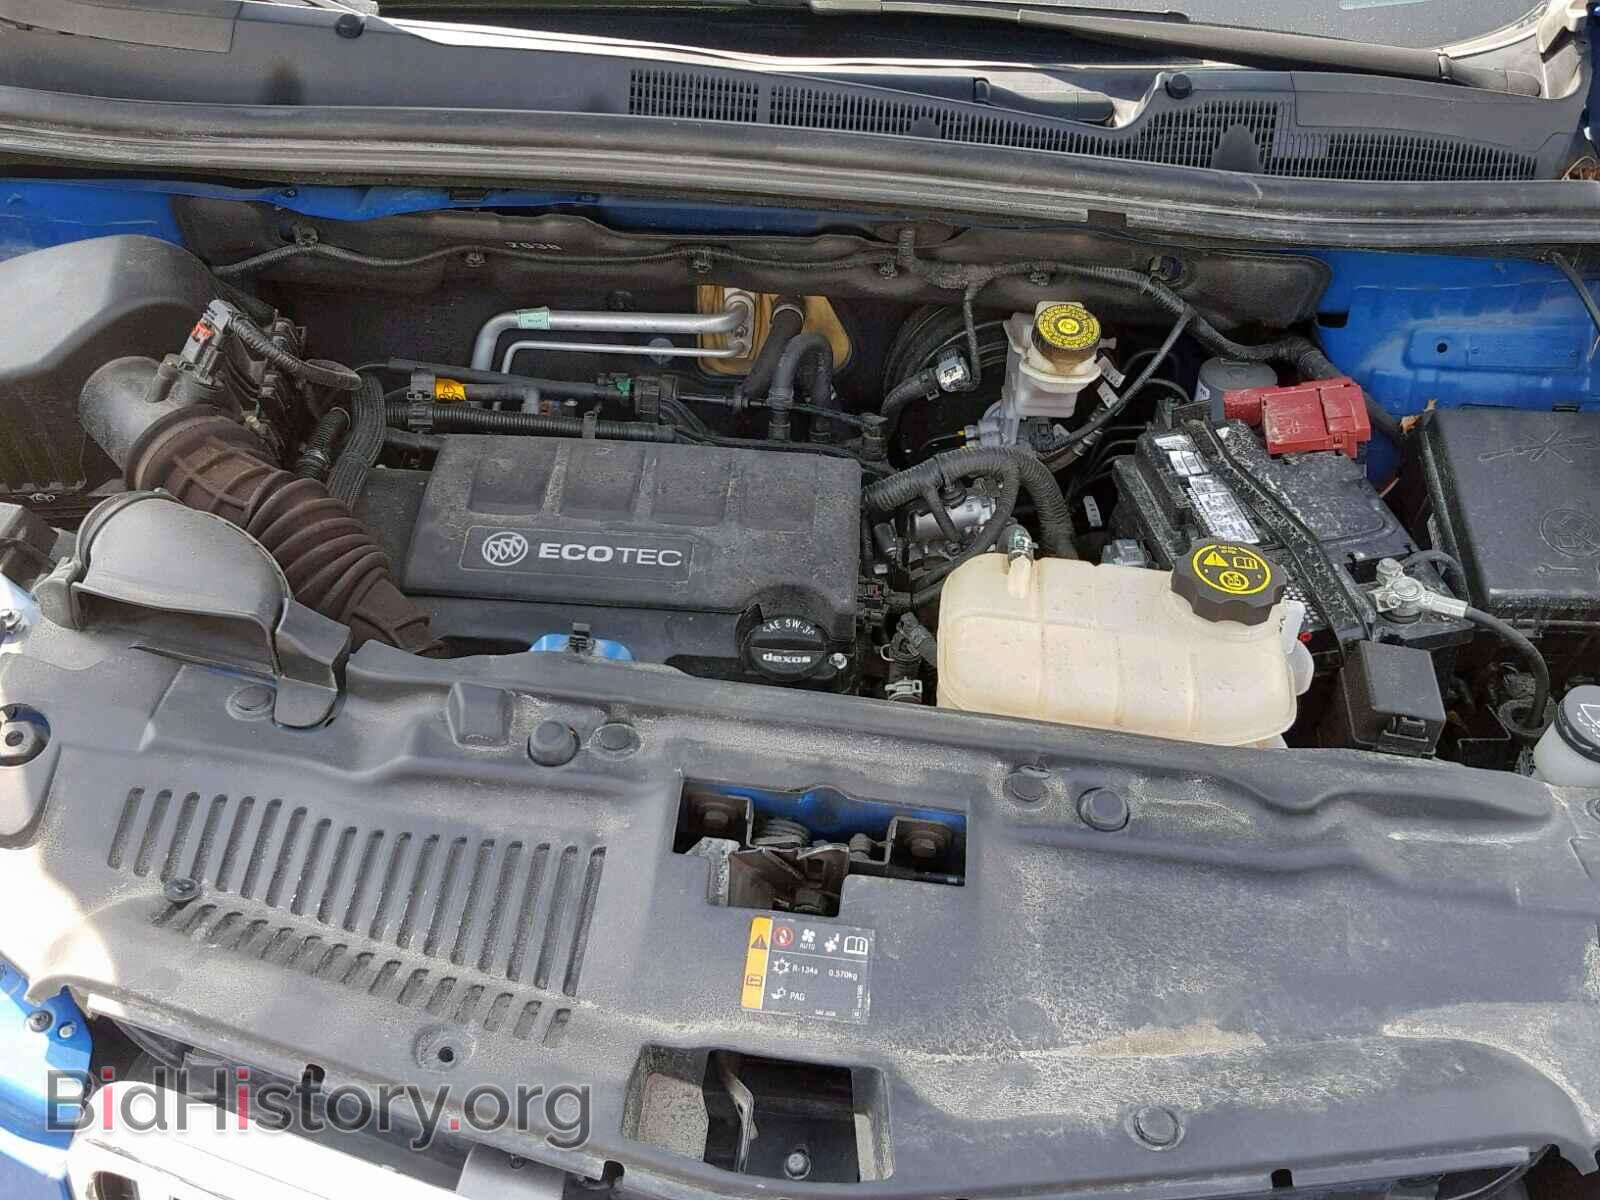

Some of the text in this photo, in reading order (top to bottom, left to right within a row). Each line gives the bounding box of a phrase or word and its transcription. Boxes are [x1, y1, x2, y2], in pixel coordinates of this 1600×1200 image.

[538, 542, 683, 567] ECOTEC
[762, 653, 812, 664] dexos
[789, 991, 806, 1002] PAG
